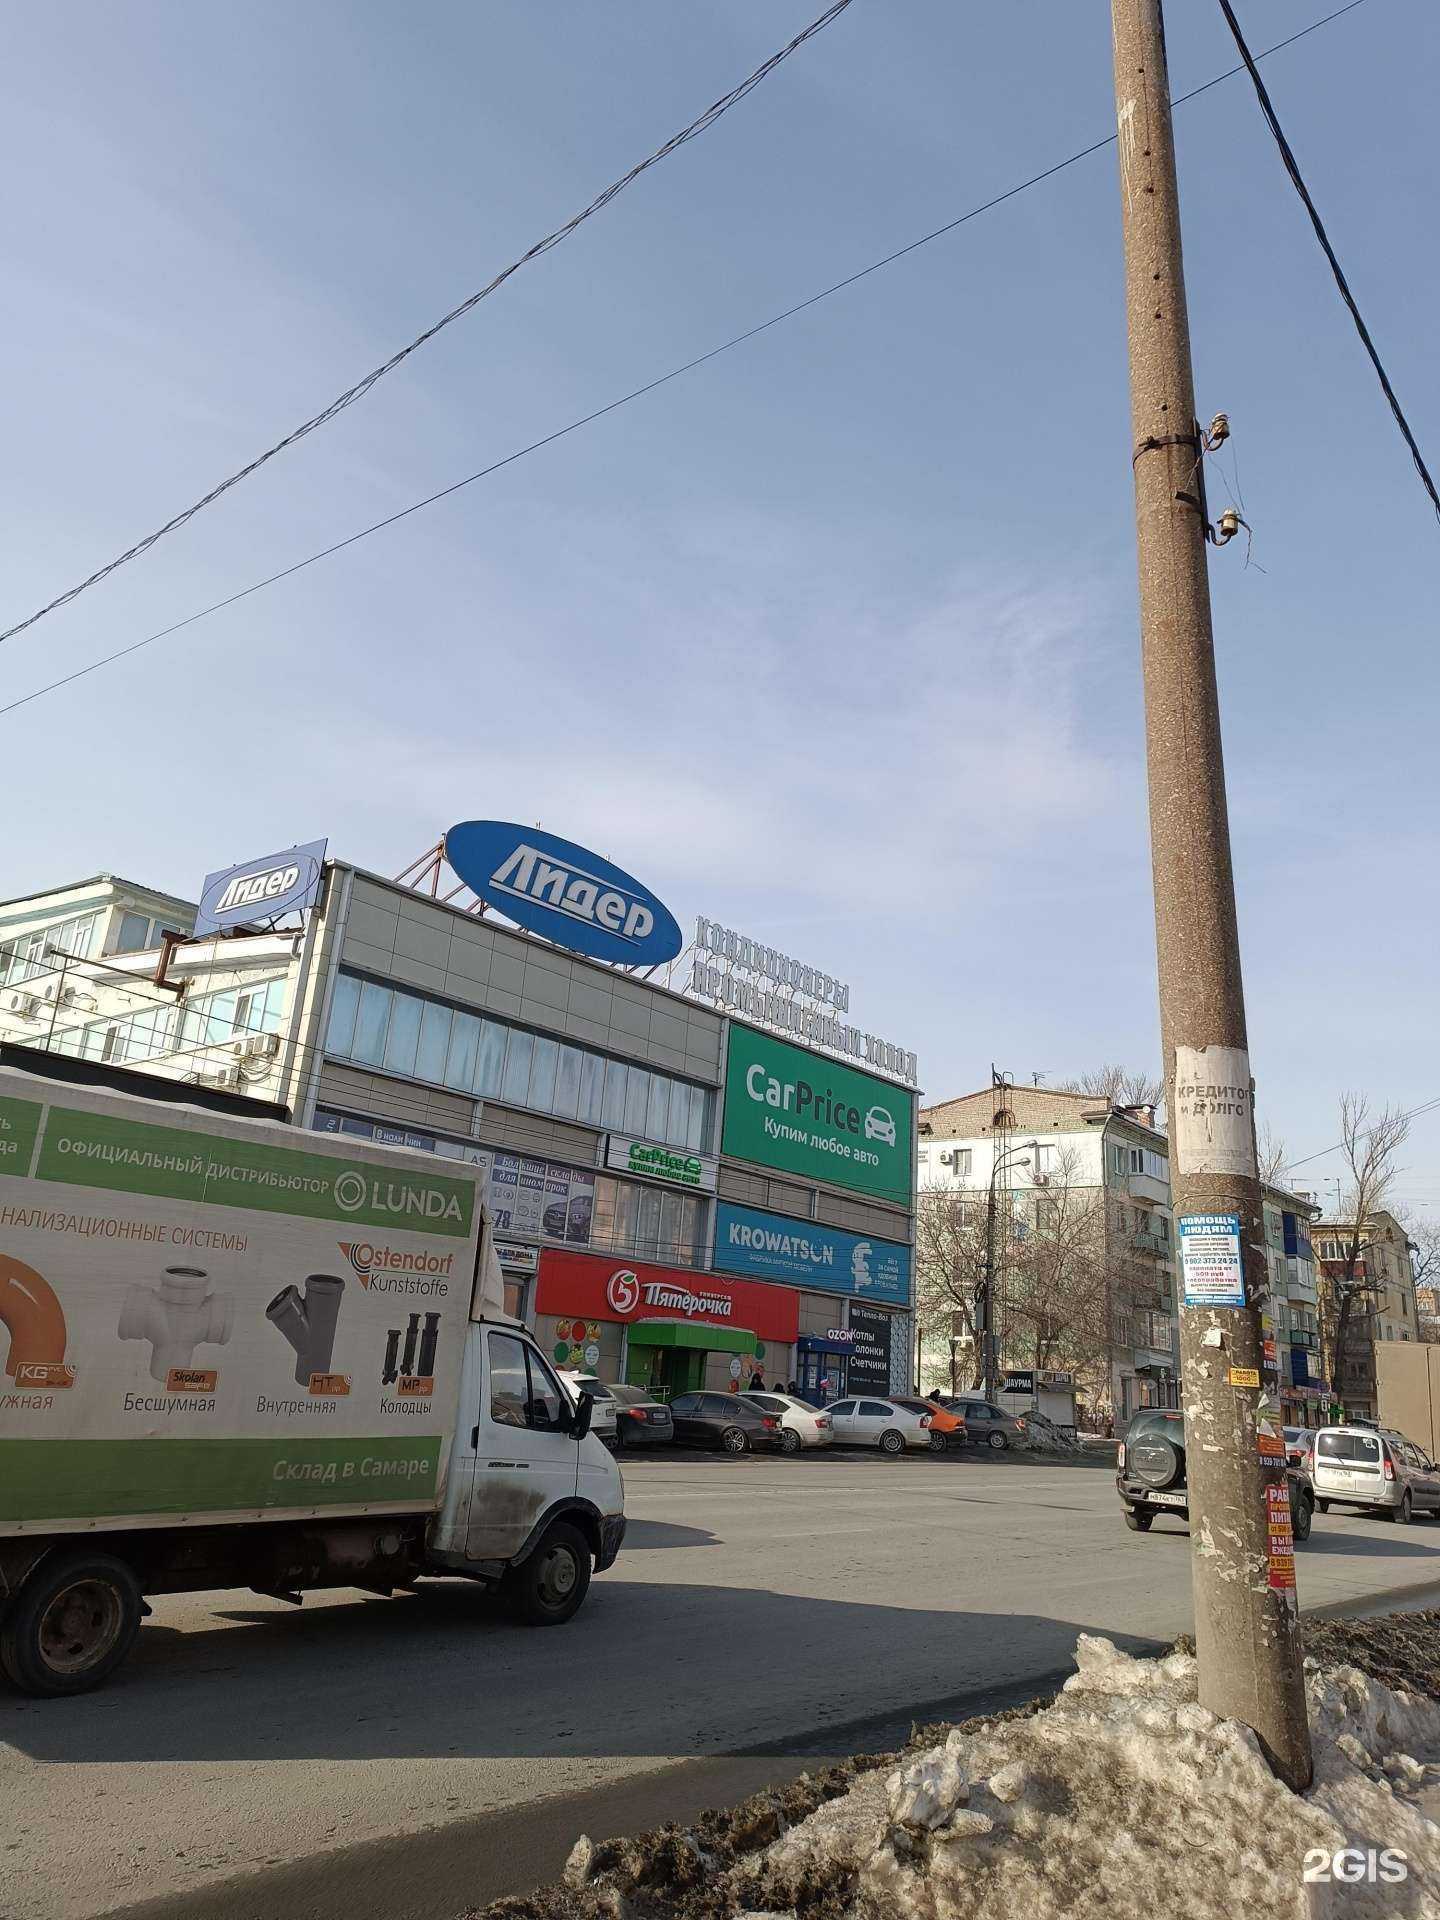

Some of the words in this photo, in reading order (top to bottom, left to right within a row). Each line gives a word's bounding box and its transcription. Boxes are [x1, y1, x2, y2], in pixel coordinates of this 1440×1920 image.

[214, 861, 300, 914] Лидер
[489, 844, 654, 946] Лидер
[695, 915, 849, 1013] КОНДИЦИОНЕРЫ
[865, 1034, 918, 1086] ХОЛОД
[746, 1064, 861, 1134] CarPrice
[764, 1116, 808, 1145] Купим
[810, 1135, 851, 1158] любое
[853, 1148, 879, 1166] авто
[57, 1138, 202, 1174] ОФИЦИАЛЬНЫЙ
[207, 1162, 329, 1194] ДИСТРИБЬЮТОР
[551, 1168, 585, 1183] склады
[499, 1172, 516, 1183] для
[520, 1177, 567, 1194] иномарок
[371, 1182, 462, 1222] LUNDA
[1, 1207, 166, 1243] НАЛИЗАЦИОННЫЕ
[172, 1227, 248, 1251] СИСТЕМЫ
[1180, 1216, 1236, 1226] ПОМОЩЬ
[1184, 1225, 1233, 1235] ЛЮДЯМ
[729, 1223, 834, 1265] KROWATSON
[357, 1244, 453, 1273] Ostendorf
[370, 1274, 448, 1297] Kunststoffe
[828, 1329, 852, 1341] OZON
[855, 1345, 884, 1356] олонки
[20, 1366, 49, 1379] KG
[850, 1357, 887, 1371] Счетчики
[173, 1372, 206, 1383] Skolan
[313, 1376, 334, 1387] HT
[1004, 1378, 1031, 1389] ШАУРМА
[124, 1393, 216, 1414] Бесшумная
[256, 1396, 337, 1416] Внутренняя
[380, 1398, 432, 1415] Колодцы
[272, 1459, 336, 1482] Склад
[343, 1461, 354, 1478] в
[360, 1457, 429, 1479] Самаре
